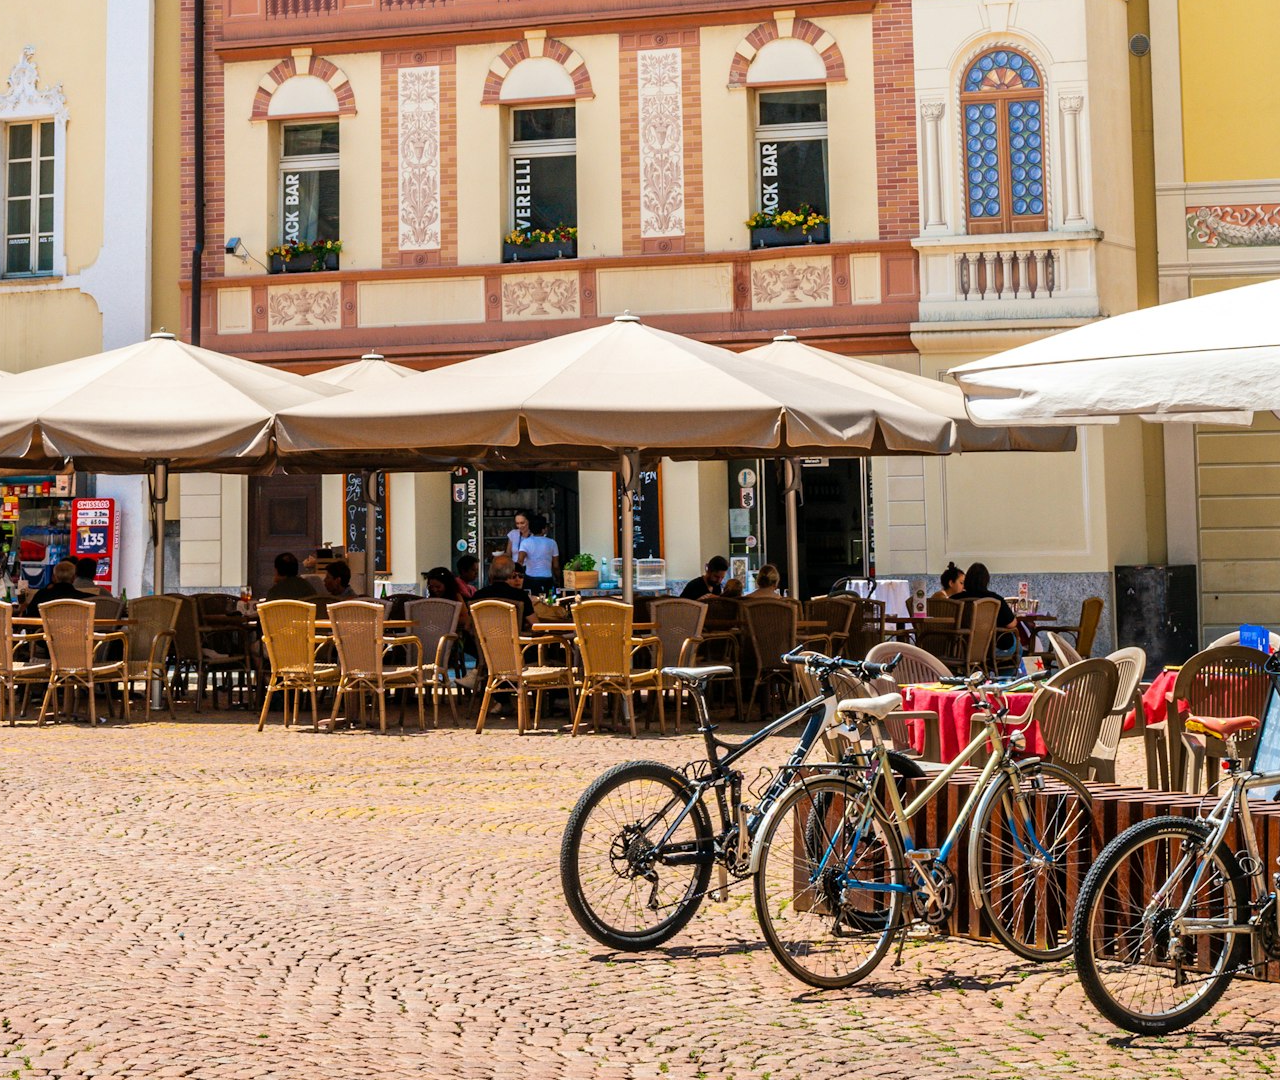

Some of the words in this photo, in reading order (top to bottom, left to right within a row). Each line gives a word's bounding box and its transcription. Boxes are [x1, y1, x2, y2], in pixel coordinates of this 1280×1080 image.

[762, 143, 778, 177] BAR
[285, 173, 300, 206] BAR
[515, 159, 531, 238] VERELLI
[763, 182, 779, 219] ACK
[285, 211, 300, 247] ACK
[467, 478, 477, 506] PIANO
[467, 515, 477, 528] AL
[83, 532, 105, 546] 135
[467, 530, 477, 554] SALA
